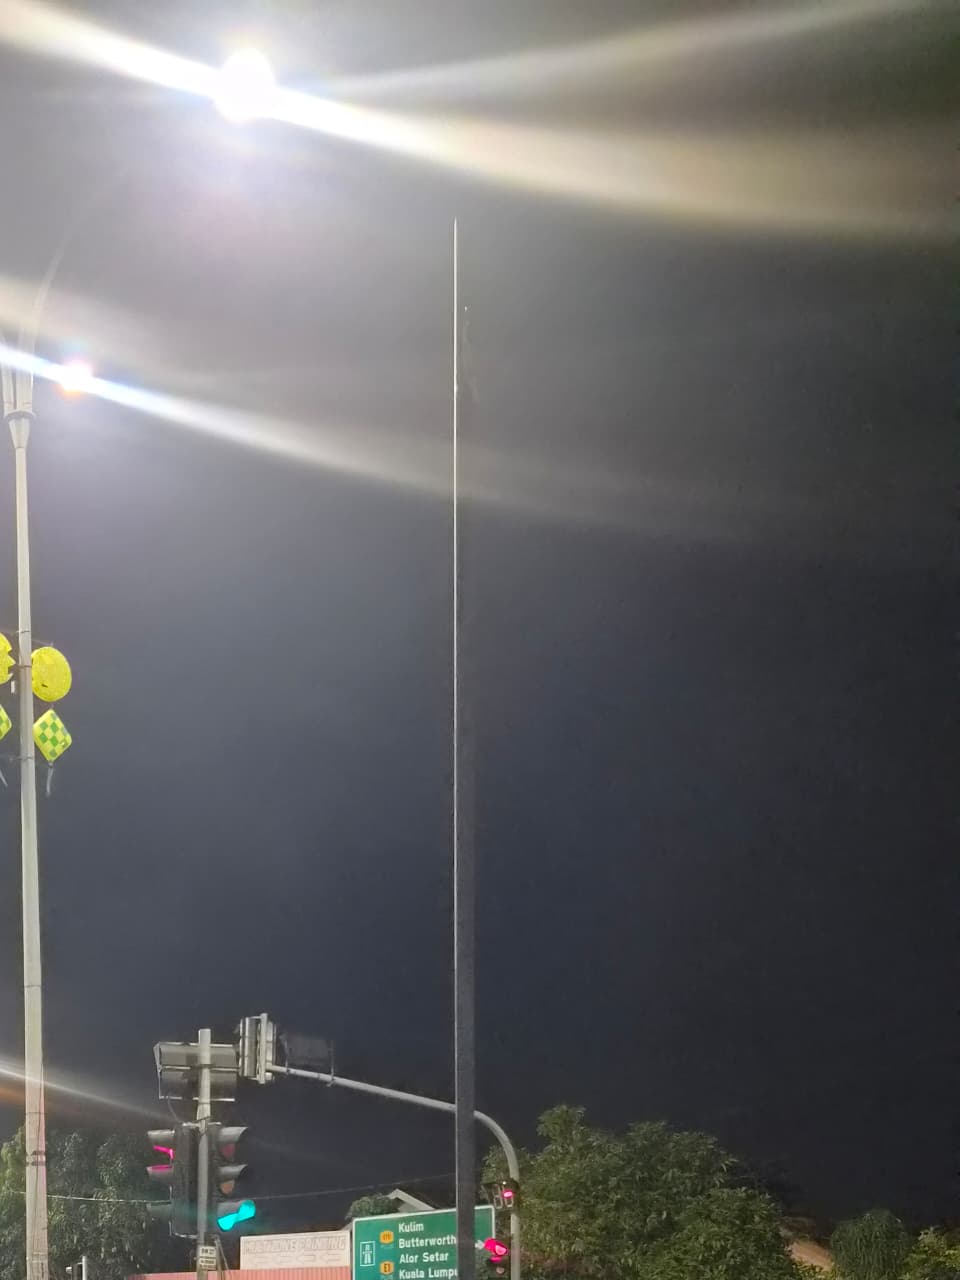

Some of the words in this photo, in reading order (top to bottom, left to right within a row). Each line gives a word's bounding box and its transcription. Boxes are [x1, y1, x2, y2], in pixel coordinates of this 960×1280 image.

[398, 1221, 424, 1233] Kulim
[398, 1234, 457, 1249] Butterworth
[399, 1253, 418, 1264] Alor
[422, 1251, 449, 1263] Setar
[399, 1268, 425, 1280] Kuala
[428, 1267, 457, 1280] Lump
